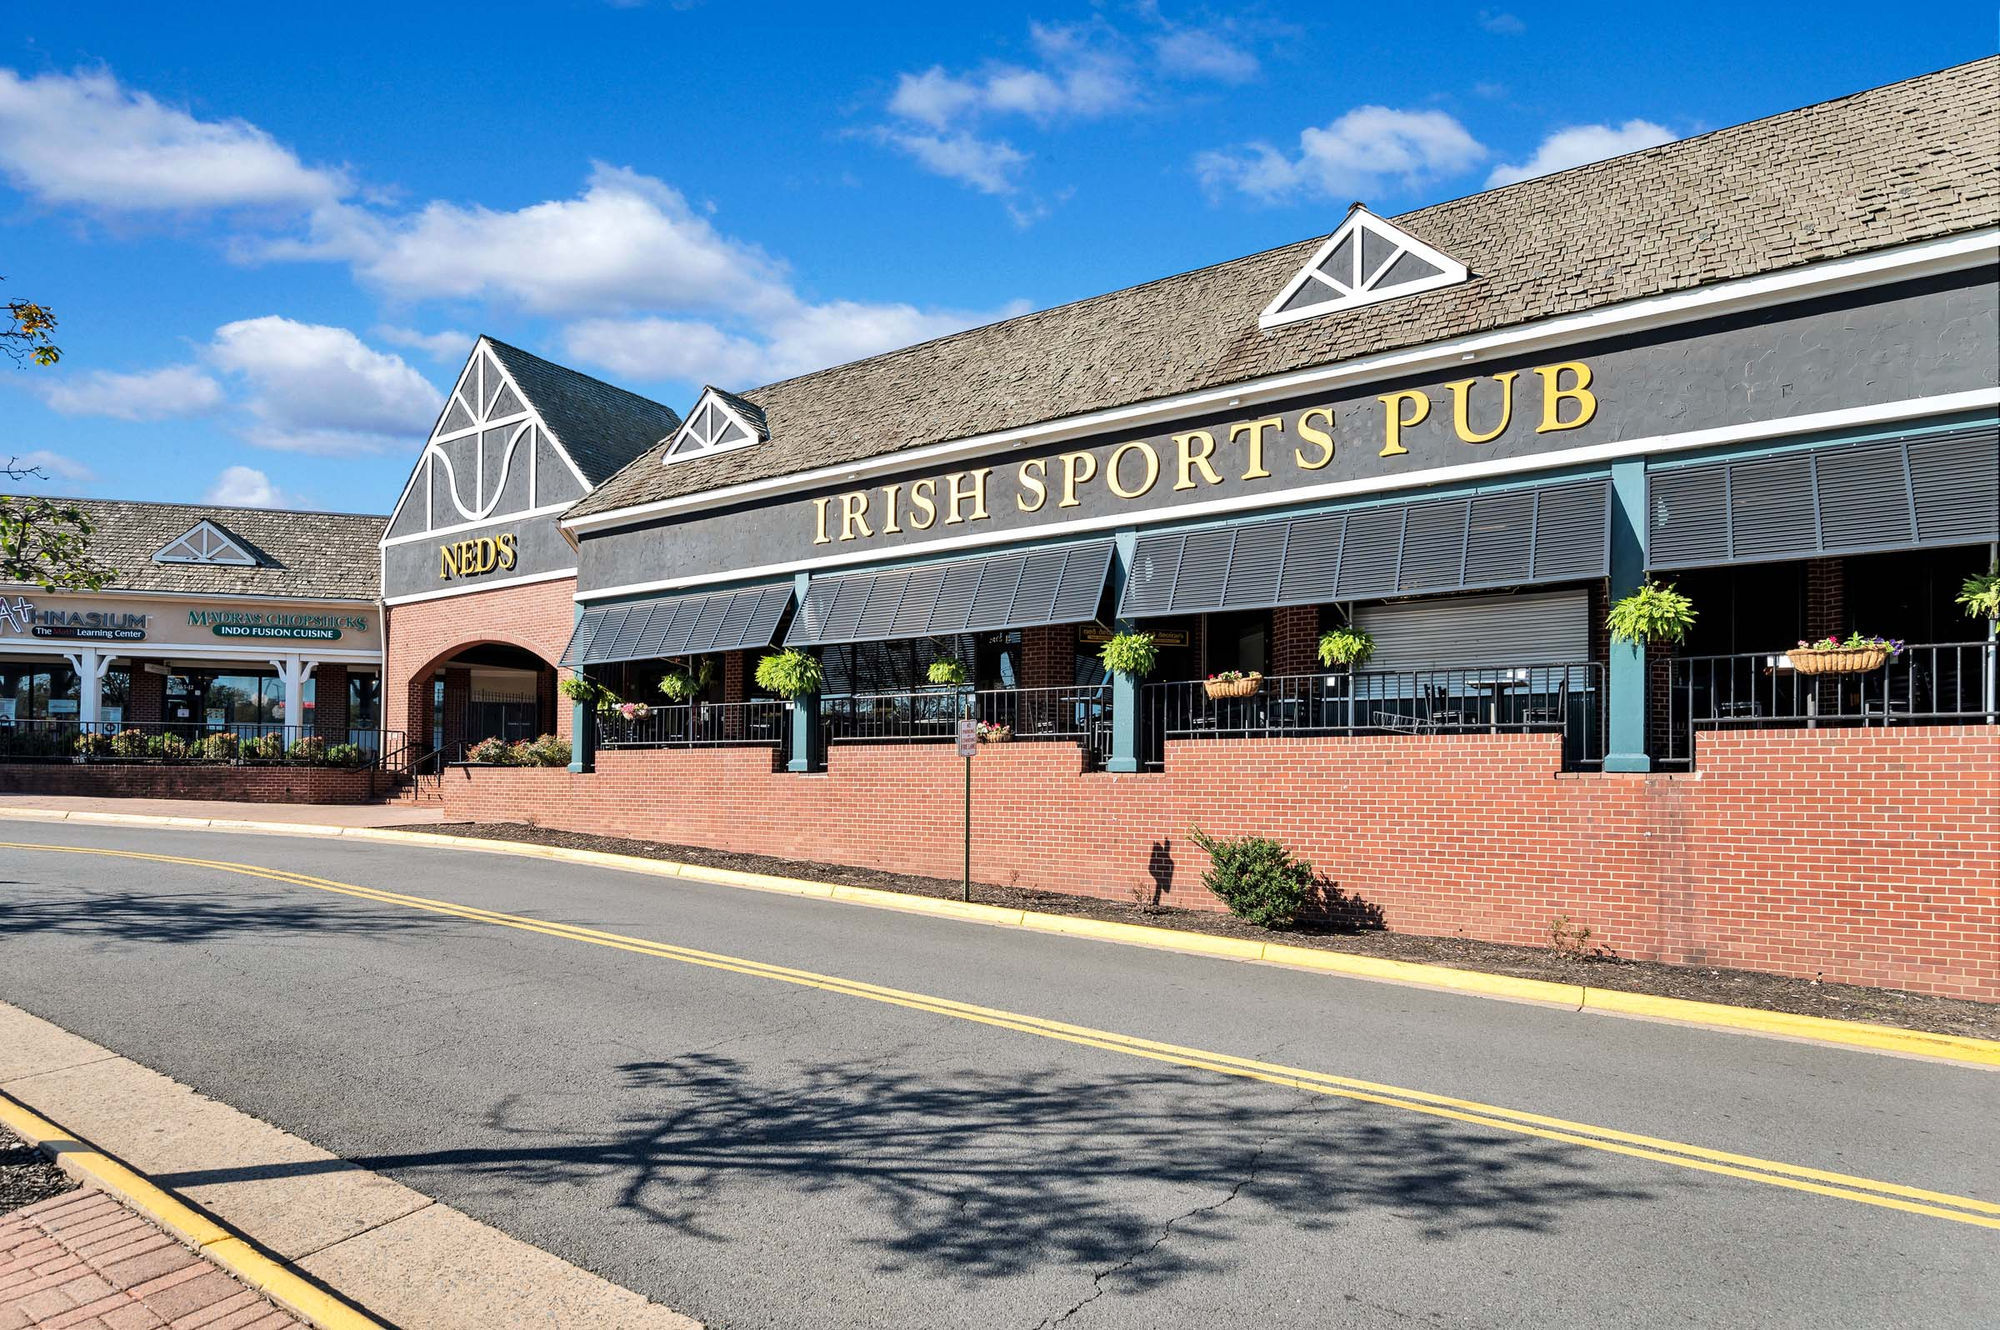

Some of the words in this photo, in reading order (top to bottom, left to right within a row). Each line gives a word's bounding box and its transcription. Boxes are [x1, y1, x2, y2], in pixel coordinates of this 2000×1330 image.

[812, 466, 993, 545] IRISH
[1015, 407, 1337, 514] SPORTS
[1376, 360, 1599, 458] PUB
[439, 532, 518, 581] NED'S
[187, 609, 262, 626] MADRAS
[266, 613, 368, 632] CHOPSTICKS
[36, 627, 52, 635] The
[77, 628, 113, 639] Learning
[114, 629, 142, 638] Center
[221, 626, 250, 636] INDO
[252, 627, 291, 637] FUSION
[293, 629, 334, 639] CUISINE
